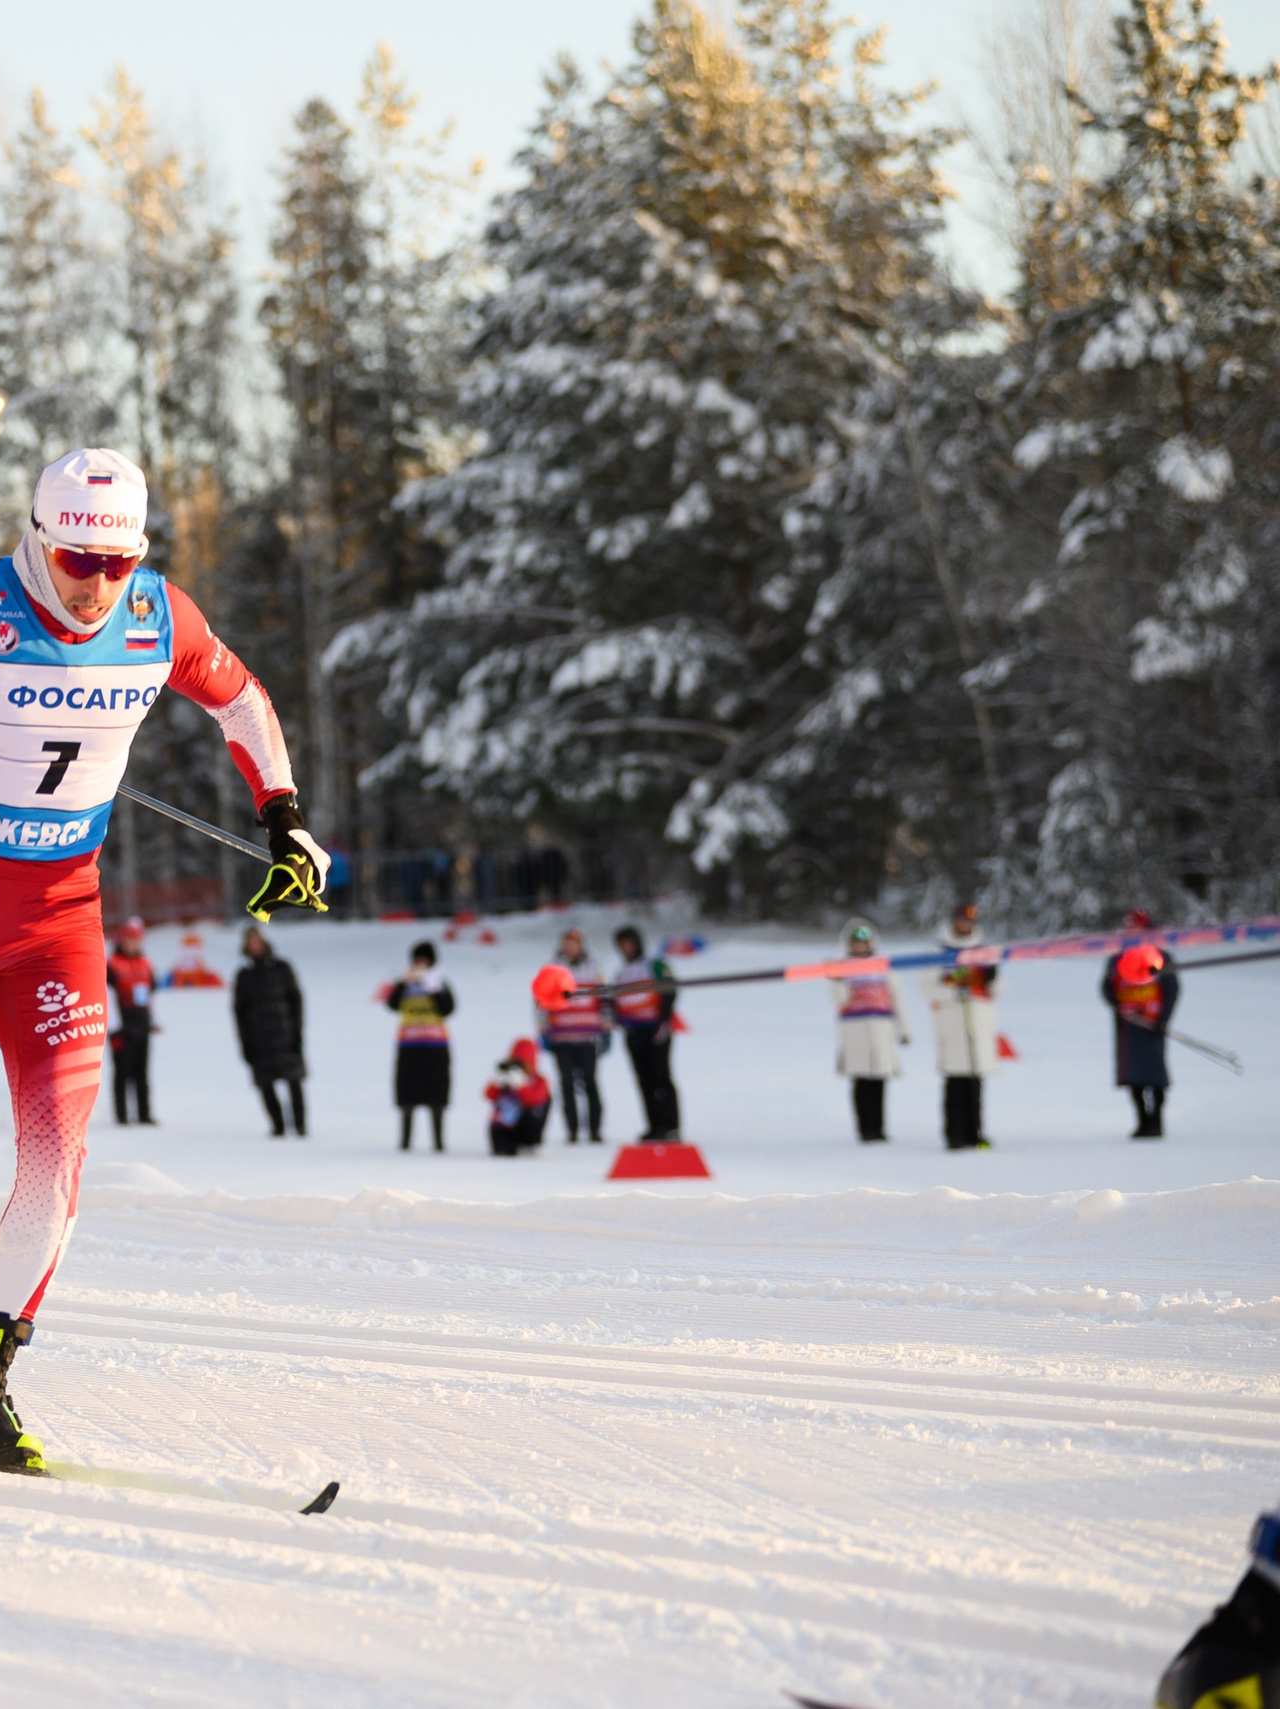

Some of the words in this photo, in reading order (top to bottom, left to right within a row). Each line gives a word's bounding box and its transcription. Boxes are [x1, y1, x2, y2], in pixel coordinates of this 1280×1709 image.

[58, 511, 139, 530] ЛУКОЙЛ
[7, 686, 158, 710] ФОСАГРО
[35, 741, 82, 795] 7
[34, 1003, 104, 1034] ФОСАГРО
[46, 1022, 105, 1047] BIVIUM
